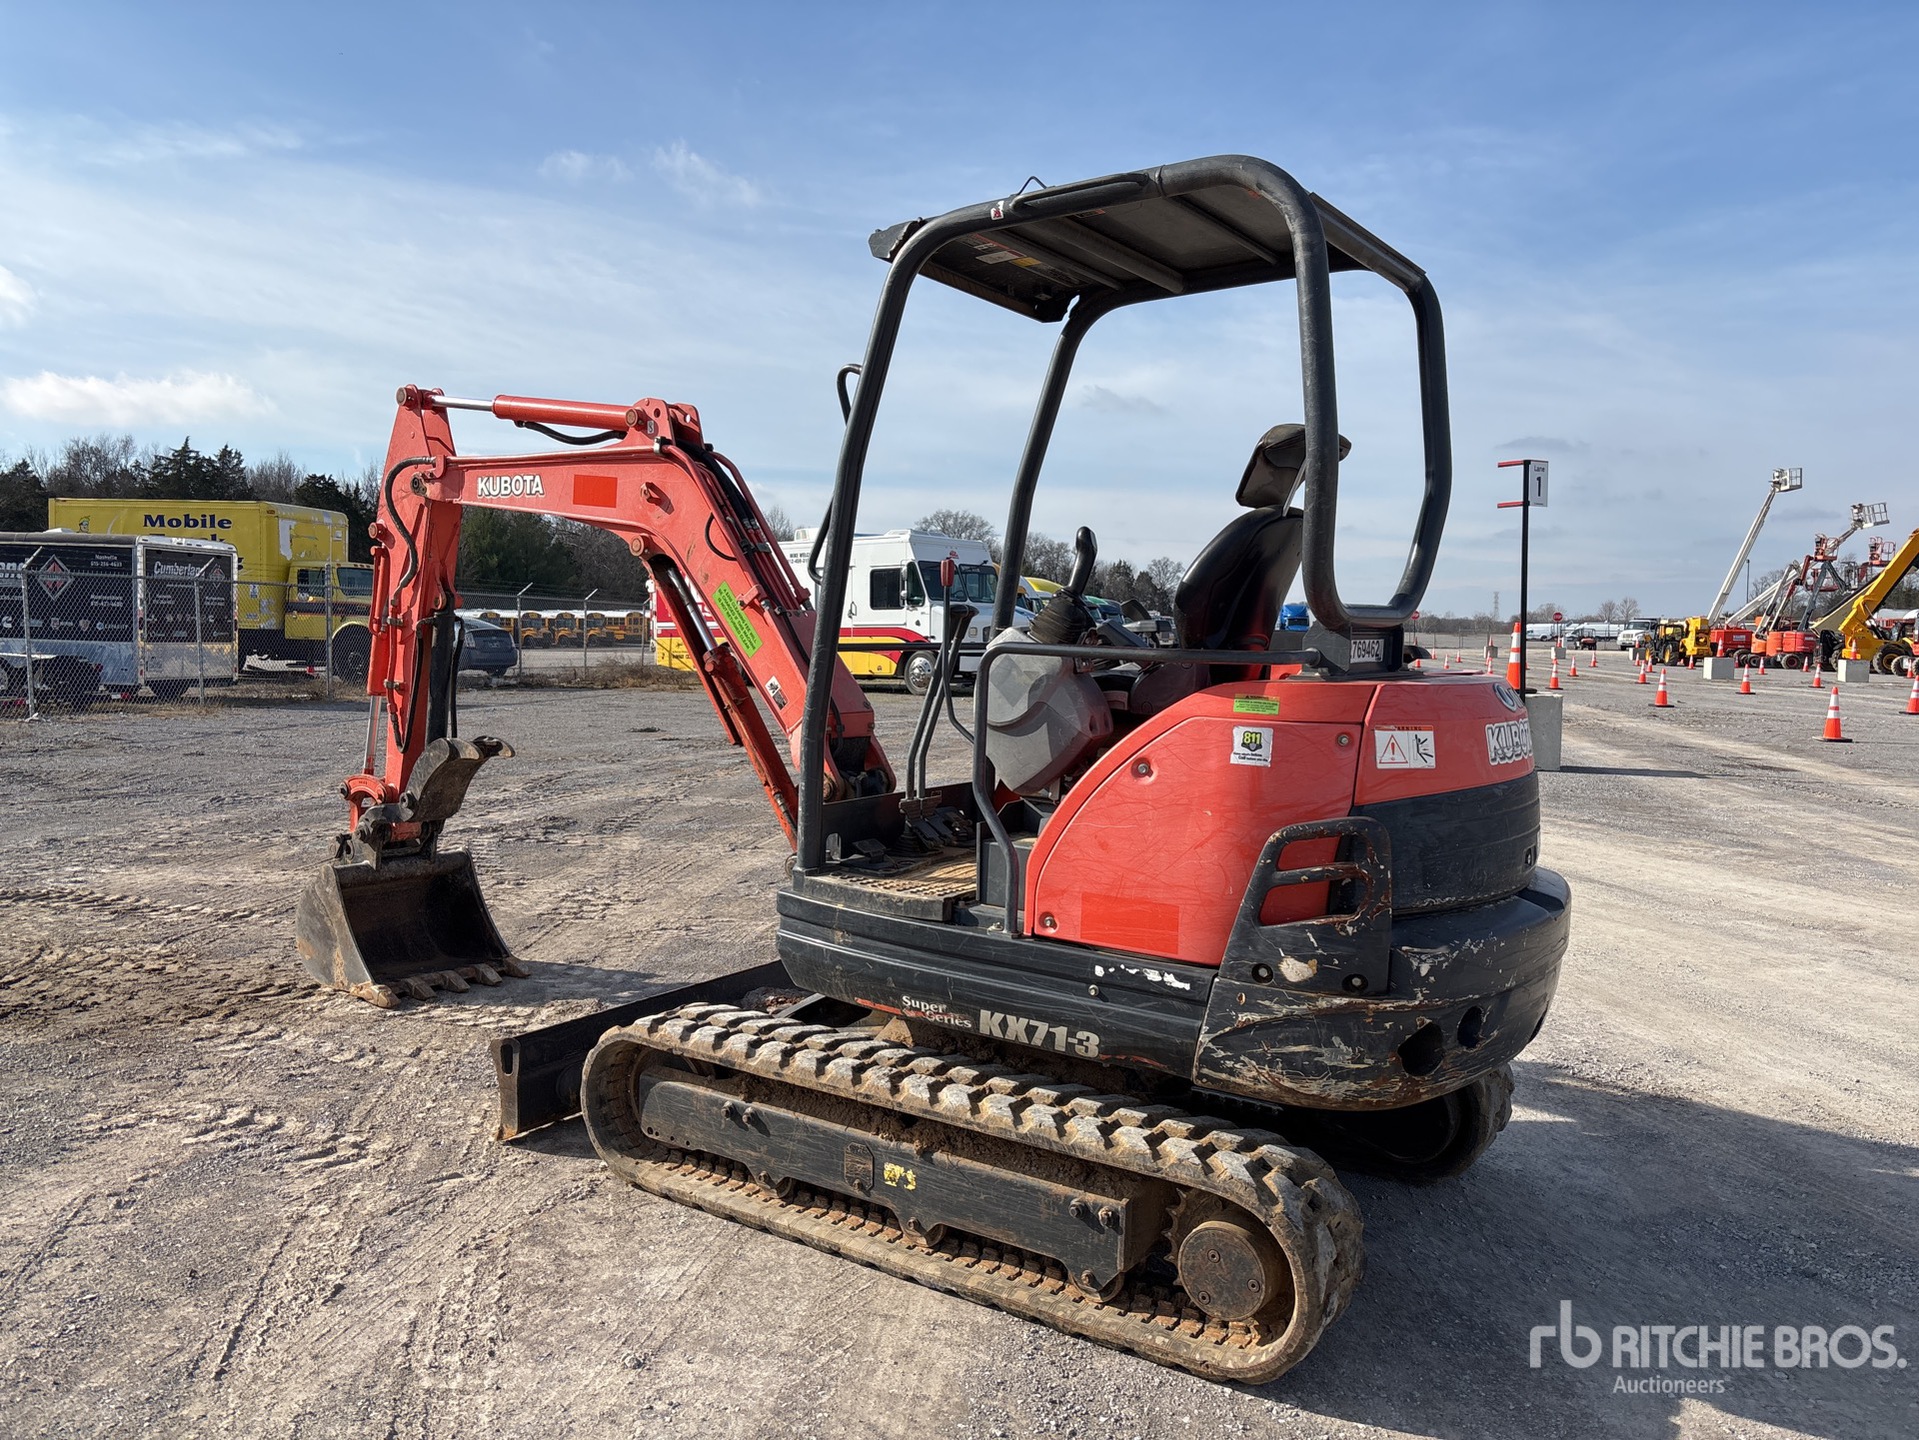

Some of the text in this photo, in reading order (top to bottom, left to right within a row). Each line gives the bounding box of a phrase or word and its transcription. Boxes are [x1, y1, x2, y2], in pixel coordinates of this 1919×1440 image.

[1534, 465, 1545, 473] Lane
[478, 474, 545, 497] KUBOTA
[1536, 476, 1541, 497] 1
[143, 513, 232, 529] Mobile
[1353, 640, 1380, 658] 769462
[1244, 732, 1261, 744] 811
[902, 995, 946, 1013] Super
[925, 1010, 972, 1028] Series
[979, 1009, 1100, 1059] KX71-3
